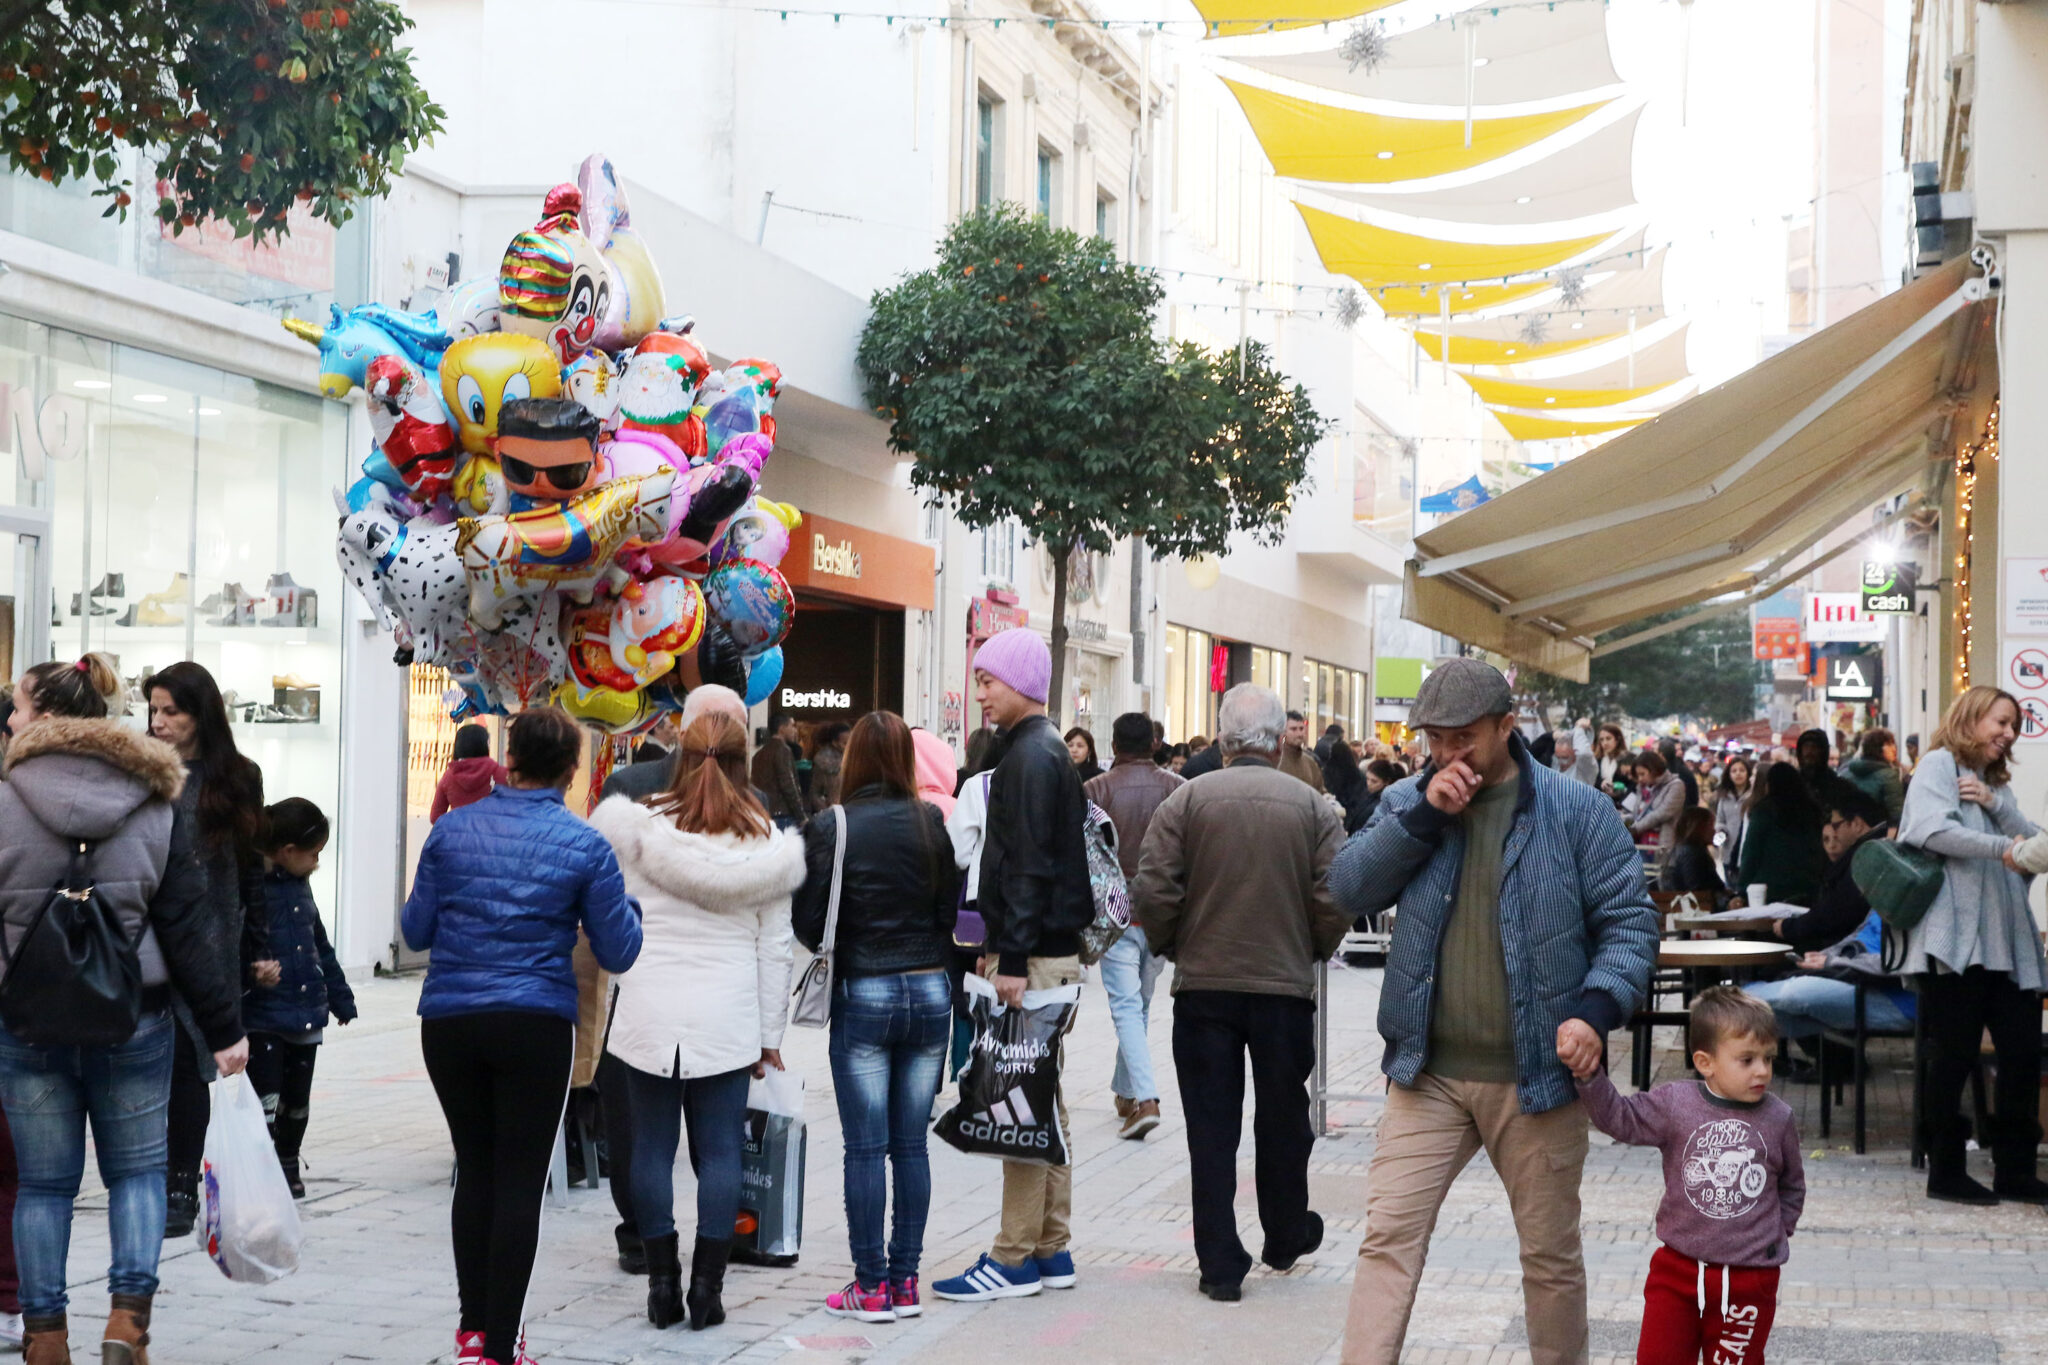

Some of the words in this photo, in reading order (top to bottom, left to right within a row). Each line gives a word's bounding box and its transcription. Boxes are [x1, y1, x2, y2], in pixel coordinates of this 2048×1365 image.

[813, 533, 862, 579] Bershka
[1865, 563, 1885, 578] 24
[1868, 593, 1908, 610] cash
[1834, 659, 1866, 687] LA
[782, 688, 851, 708] Bershka
[994, 1061, 1036, 1074] SORTS
[959, 1120, 1049, 1149] adidas
[1710, 1122, 1742, 1133] STRONG
[1697, 1130, 1749, 1149] Spirit
